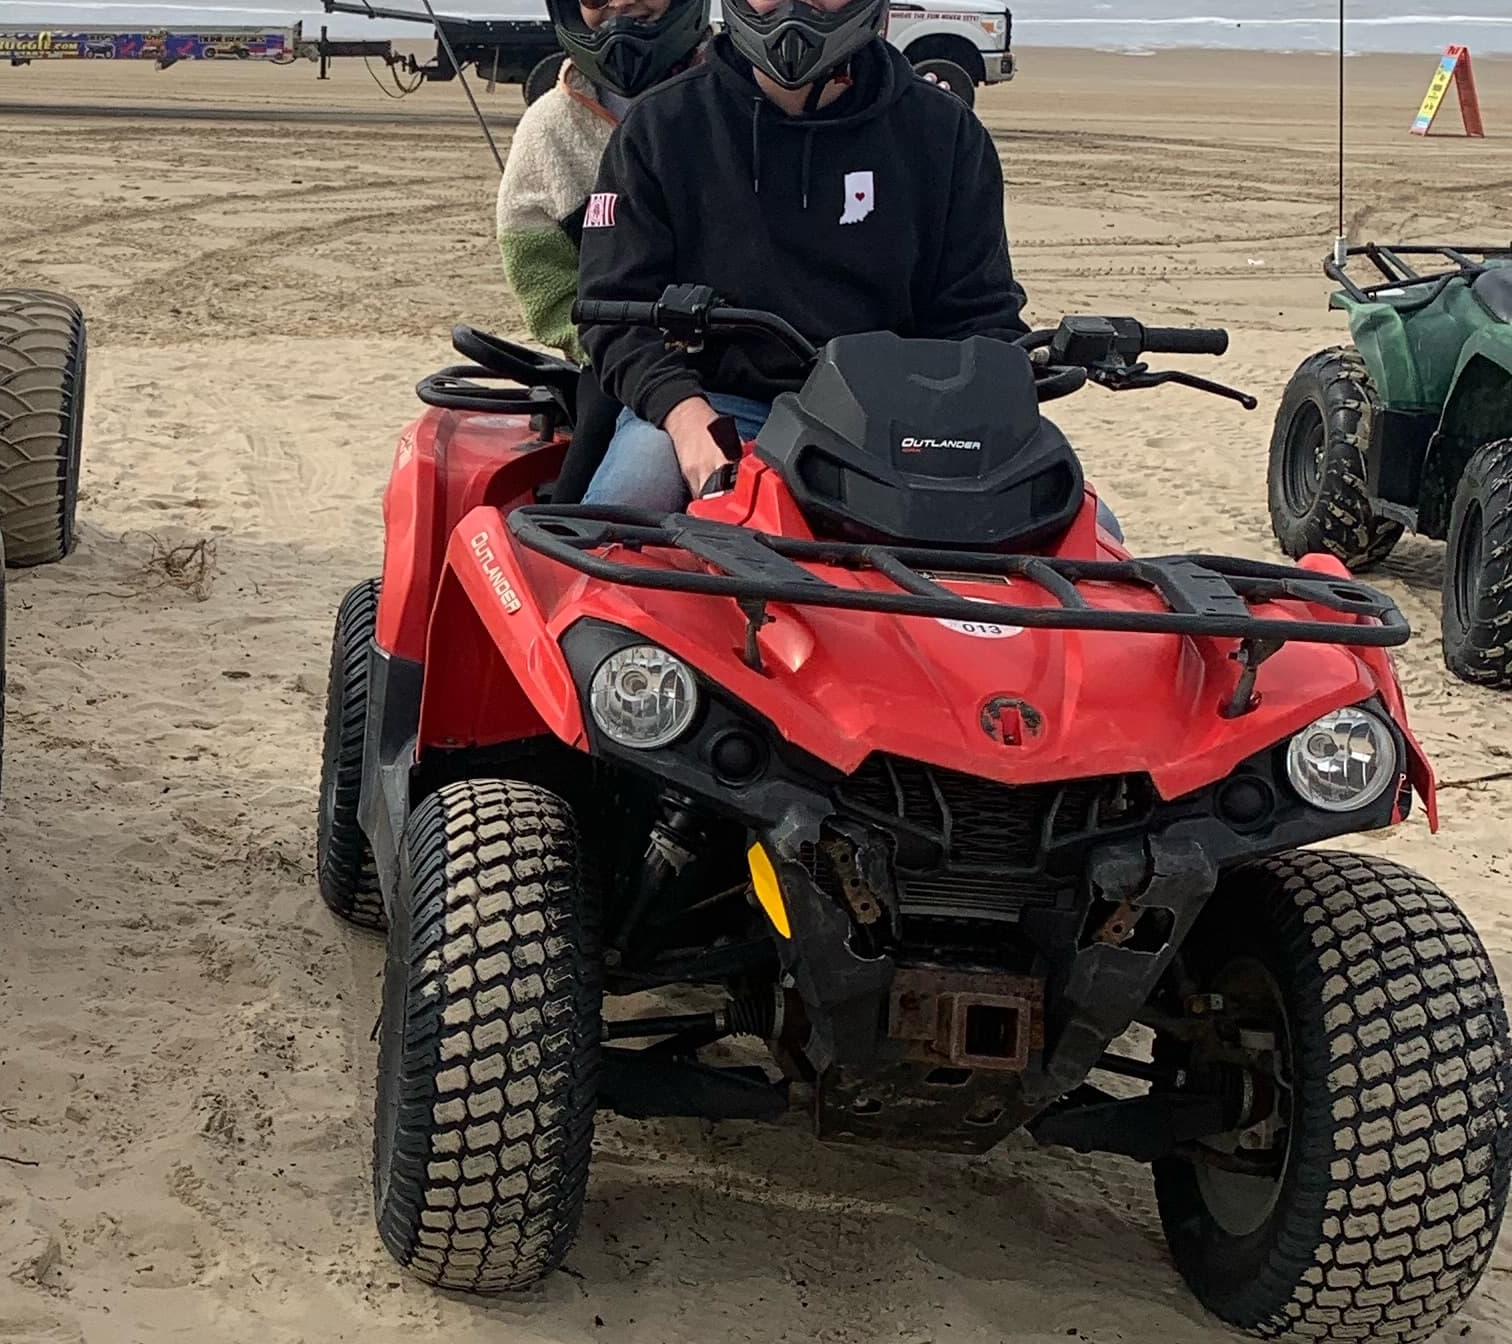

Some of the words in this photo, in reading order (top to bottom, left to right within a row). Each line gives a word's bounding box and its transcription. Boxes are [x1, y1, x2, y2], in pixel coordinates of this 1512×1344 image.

[901, 437, 981, 450] OUTLANDER
[471, 531, 522, 614] OUTLANDER
[962, 623, 1003, 635] 013
